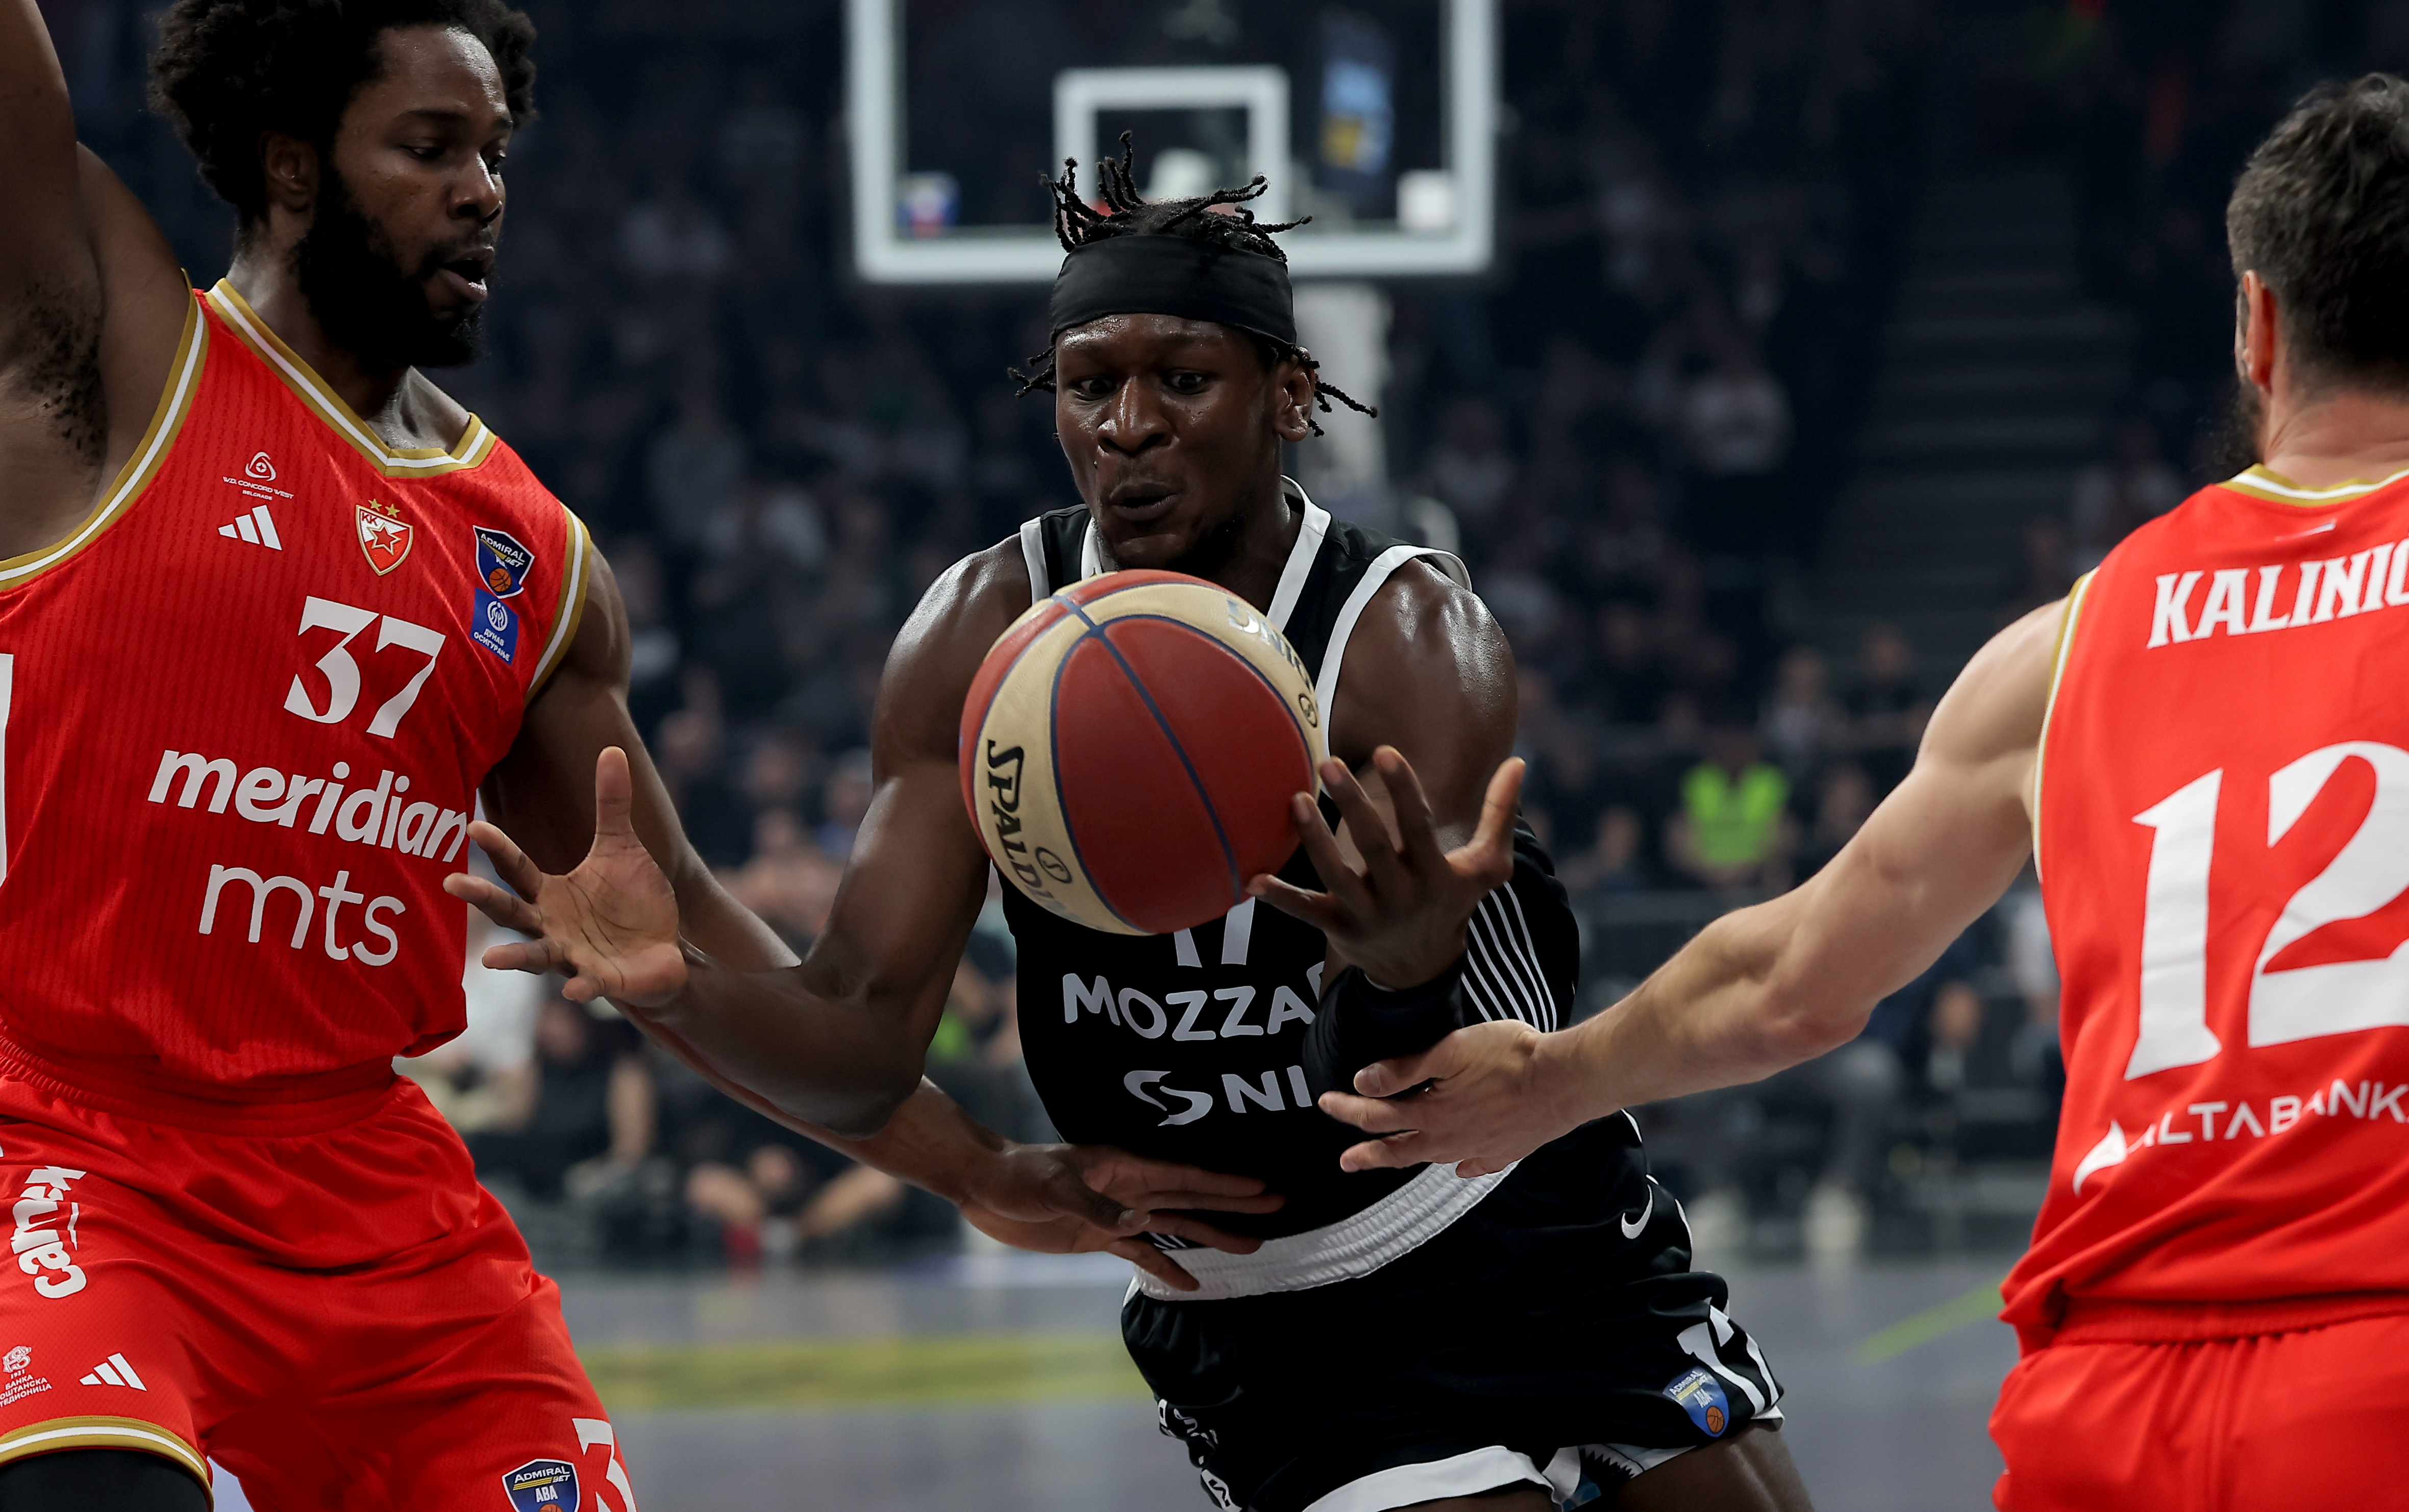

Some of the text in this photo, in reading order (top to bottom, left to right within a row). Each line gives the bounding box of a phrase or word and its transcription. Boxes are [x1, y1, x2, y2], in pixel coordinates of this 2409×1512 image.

[238, 480, 273, 493] CONCORD
[274, 488, 294, 499] WEST
[242, 489, 273, 501] BELGRADE
[480, 533, 526, 563] ADMIRAL
[504, 556, 524, 568] BET
[473, 631, 511, 662] ОСИГУРАЊЕ
[483, 627, 505, 647] ДУНАВ
[283, 595, 446, 739] 37
[147, 749, 467, 863] meridian
[198, 864, 406, 967] mts
[2124, 740, 2409, 1081] 12
[1221, 1065, 1313, 1114] NI
[5, 1374, 34, 1391] БАНКА
[10, 1369, 26, 1379] 1921
[1669, 1370, 1703, 1395] ADMIRAL
[0, 1377, 48, 1400] ОШТАНСКА
[0, 1383, 53, 1407] ТЕДИОНИЦА
[514, 1465, 570, 1484] ADMIRAL
[552, 1474, 571, 1483] BET
[535, 1484, 559, 1503] ABA
